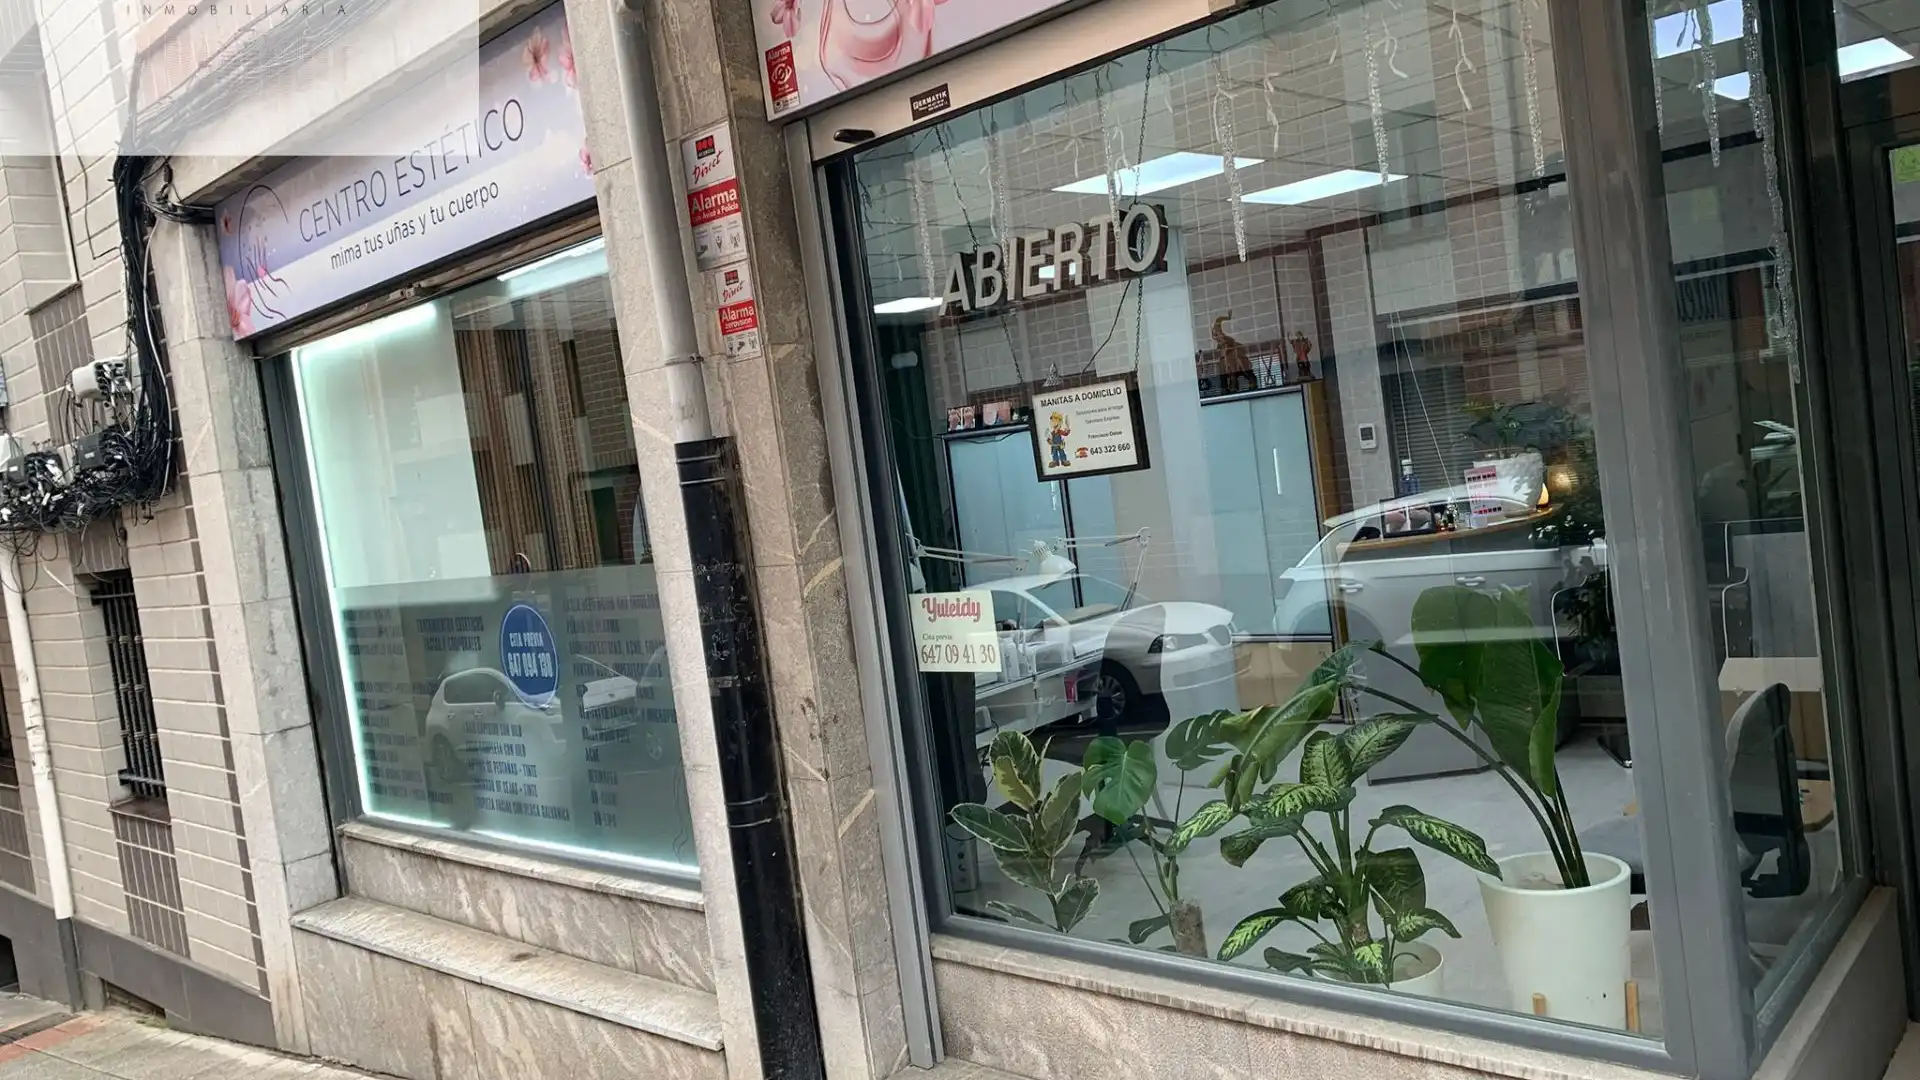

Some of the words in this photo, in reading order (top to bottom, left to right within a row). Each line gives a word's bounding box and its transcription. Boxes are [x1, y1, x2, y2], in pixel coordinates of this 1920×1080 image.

[300, 170, 387, 242] CENTRO
[394, 99, 524, 196] ESTÉTICO
[692, 188, 738, 215] Alarma
[330, 244, 362, 270] mima
[365, 232, 384, 253] tus
[387, 219, 416, 245] uñas
[418, 214, 428, 236] y
[431, 207, 445, 226] tu
[448, 181, 499, 218] cuerpo
[939, 202, 1161, 316] ABIERTO
[721, 305, 755, 322] Alarma
[1040, 395, 1073, 408] MANITAS
[1081, 386, 1122, 401] DOMICILIO
[1090, 446, 1103, 455] 643
[1103, 445, 1116, 454] 322
[1117, 442, 1131, 452] 660
[921, 597, 981, 623] Yuleidy
[509, 632, 523, 647] CITA
[523, 632, 544, 647] PREVIA
[922, 633, 935, 641] Cita
[508, 652, 521, 677] 647
[521, 652, 538, 677] 094
[538, 652, 554, 677] 130
[921, 644, 942, 664] 647
[945, 644, 959, 664] 09
[963, 644, 977, 664] 41
[980, 644, 996, 664] 30
